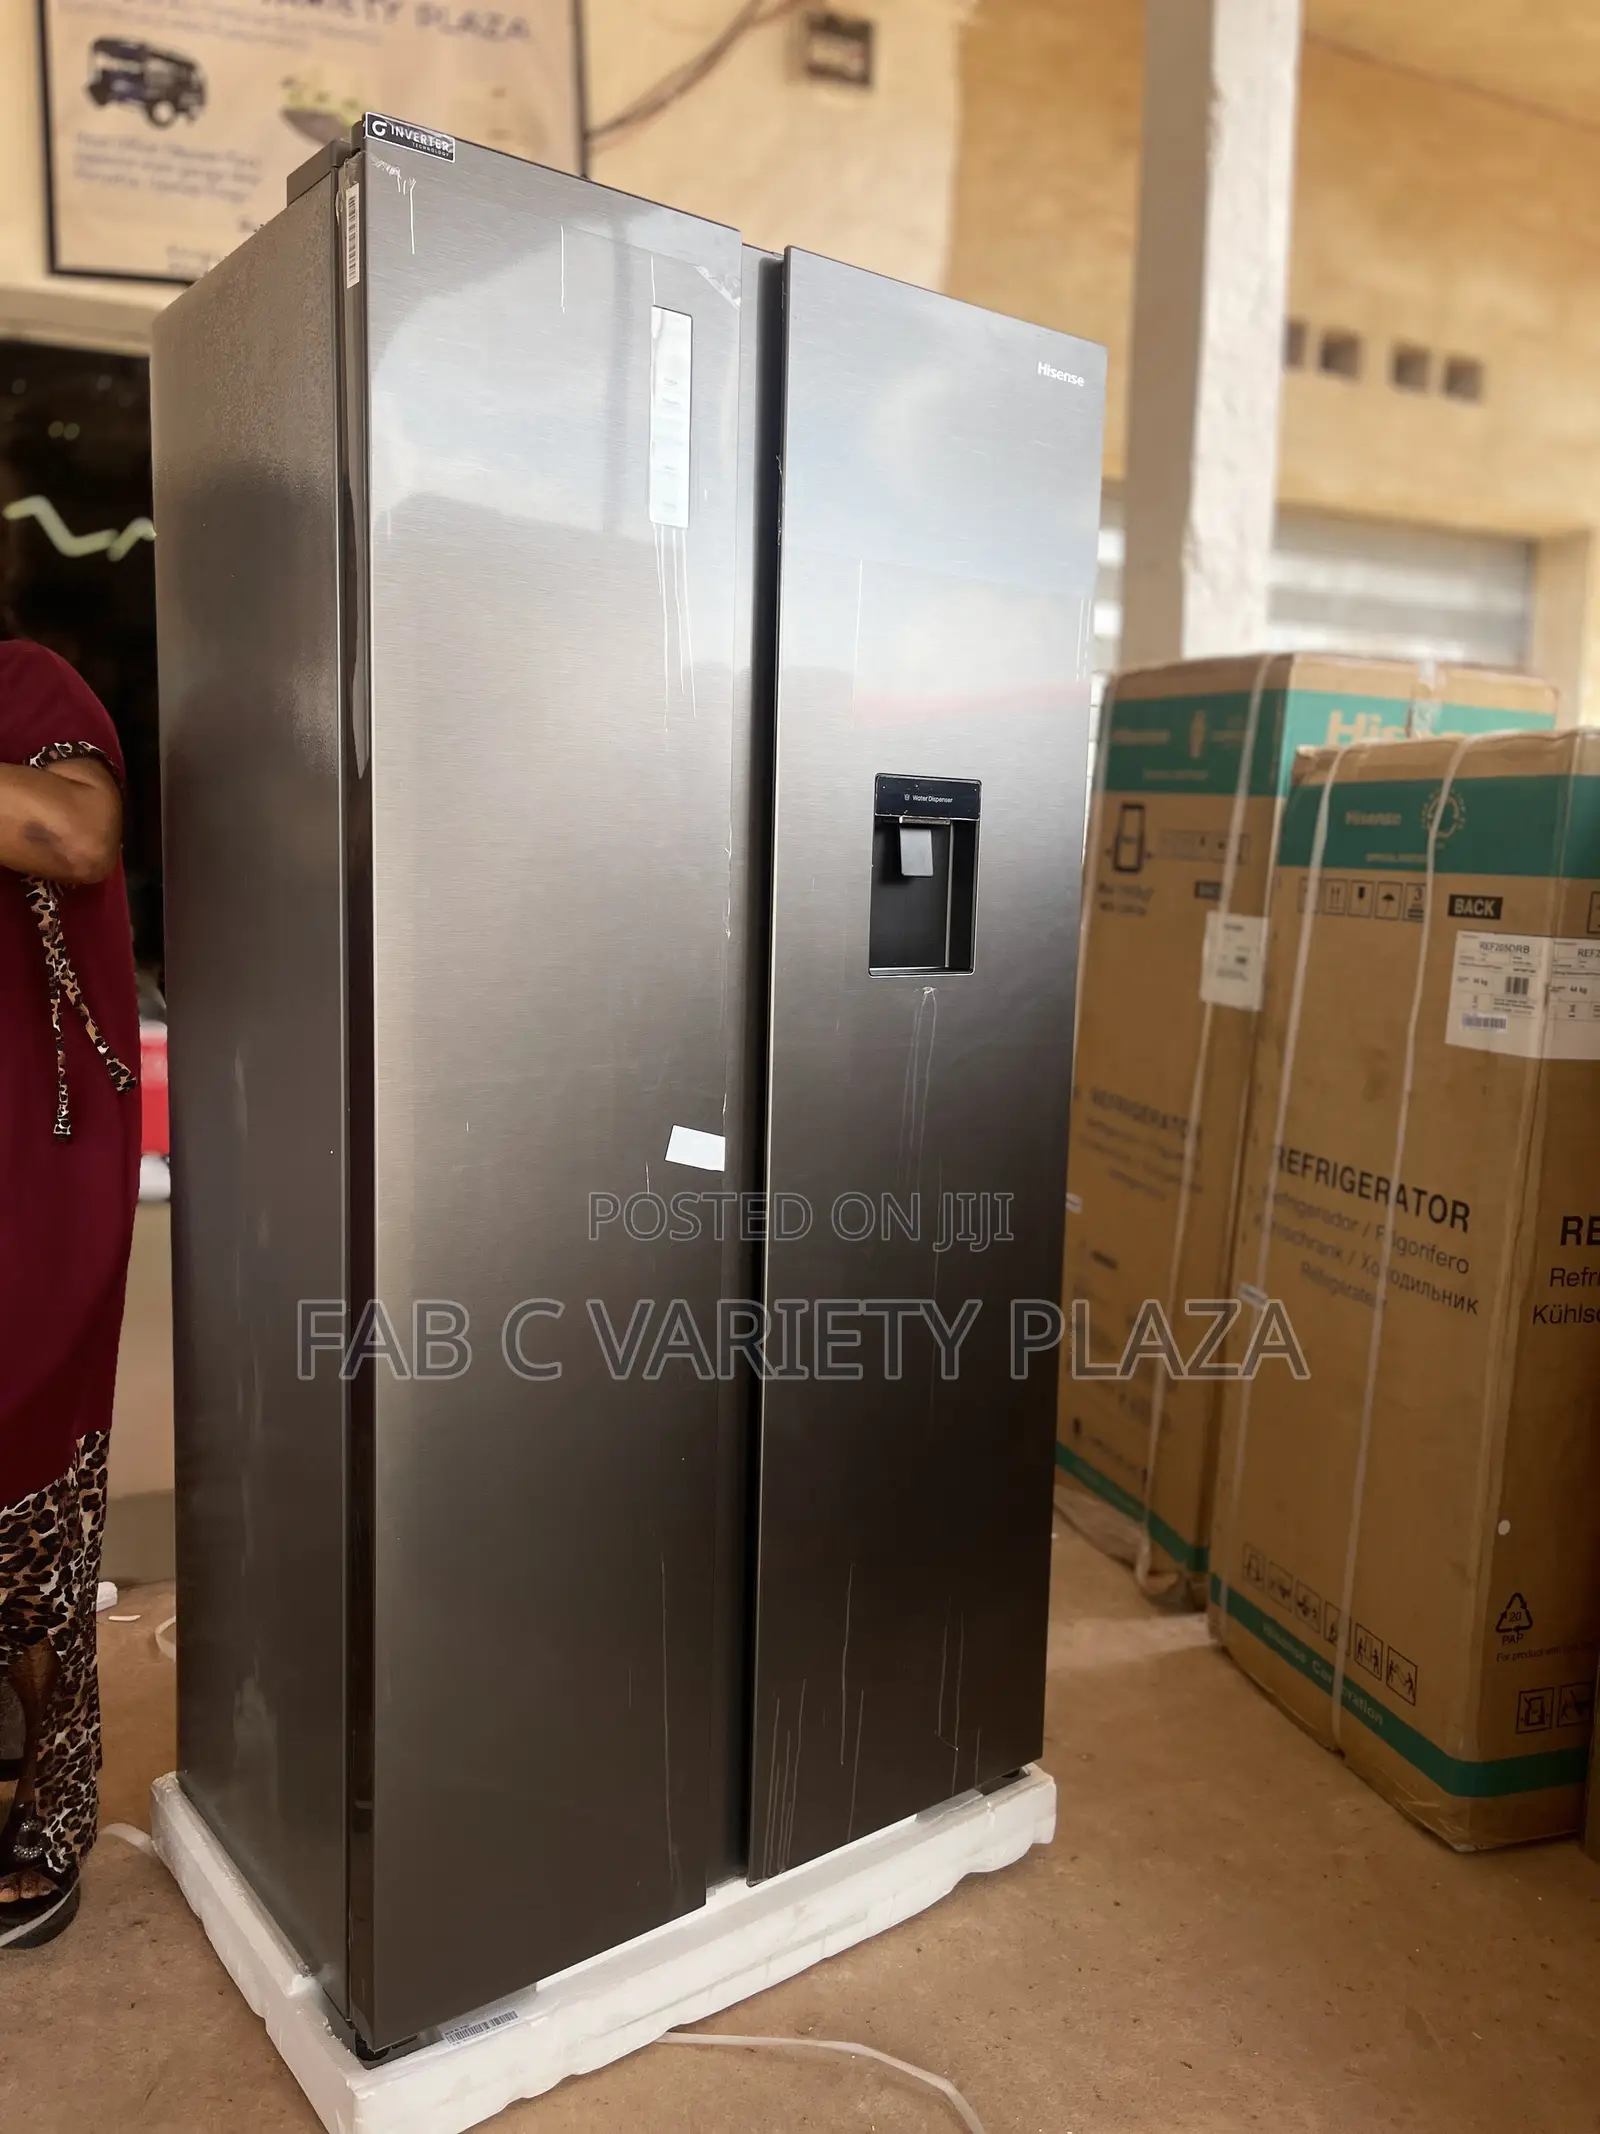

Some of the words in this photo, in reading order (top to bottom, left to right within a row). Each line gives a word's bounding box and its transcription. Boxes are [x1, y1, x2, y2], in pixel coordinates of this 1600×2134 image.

[391, 124, 449, 151] INVERTER
[412, 141, 449, 157] TECHNOLOGY
[1037, 361, 1085, 387] Hisense
[1453, 897, 1496, 916] BACK
[1502, 1633, 1524, 1646] PAP
